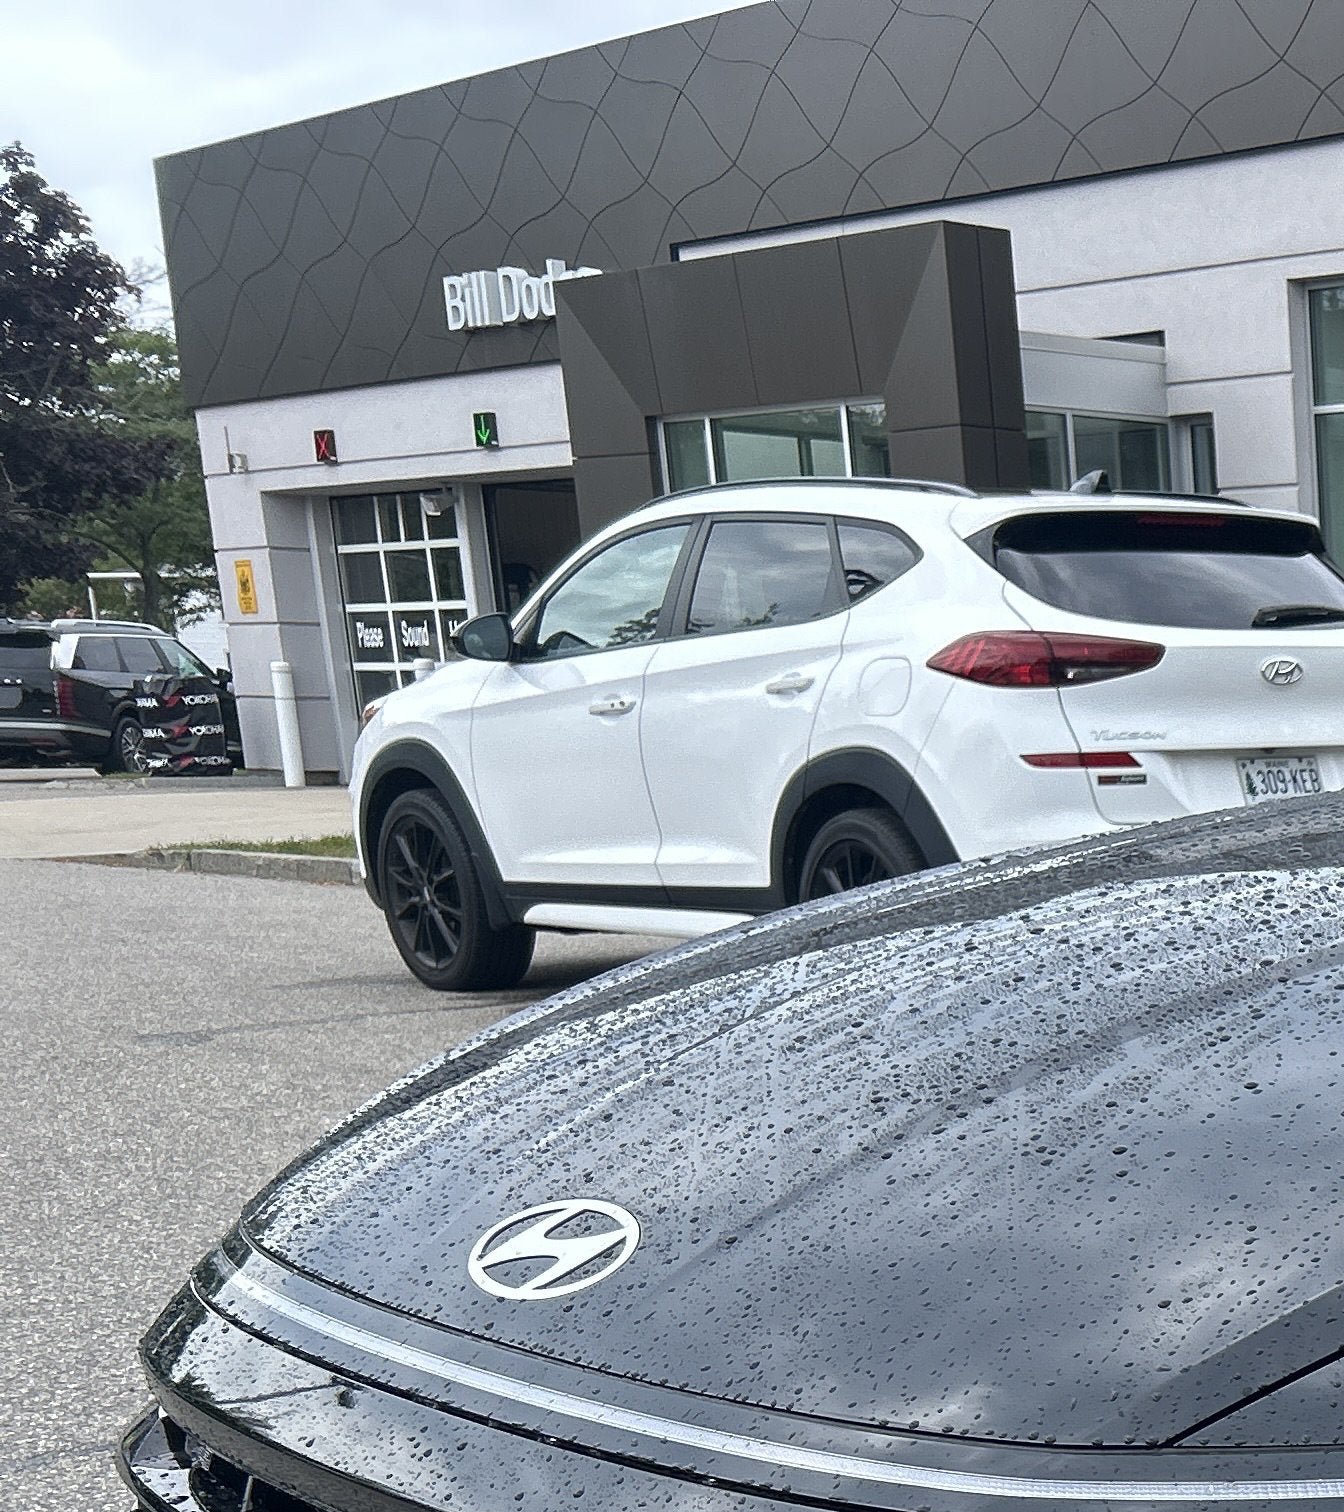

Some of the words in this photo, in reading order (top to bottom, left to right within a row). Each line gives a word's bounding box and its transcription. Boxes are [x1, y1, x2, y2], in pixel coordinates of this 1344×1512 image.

[443, 271, 502, 331] Bill
[497, 258, 604, 323] Dod
[401, 619, 430, 647] Sound
[181, 694, 219, 706] YOKOHA
[188, 724, 225, 736] YOKOHA
